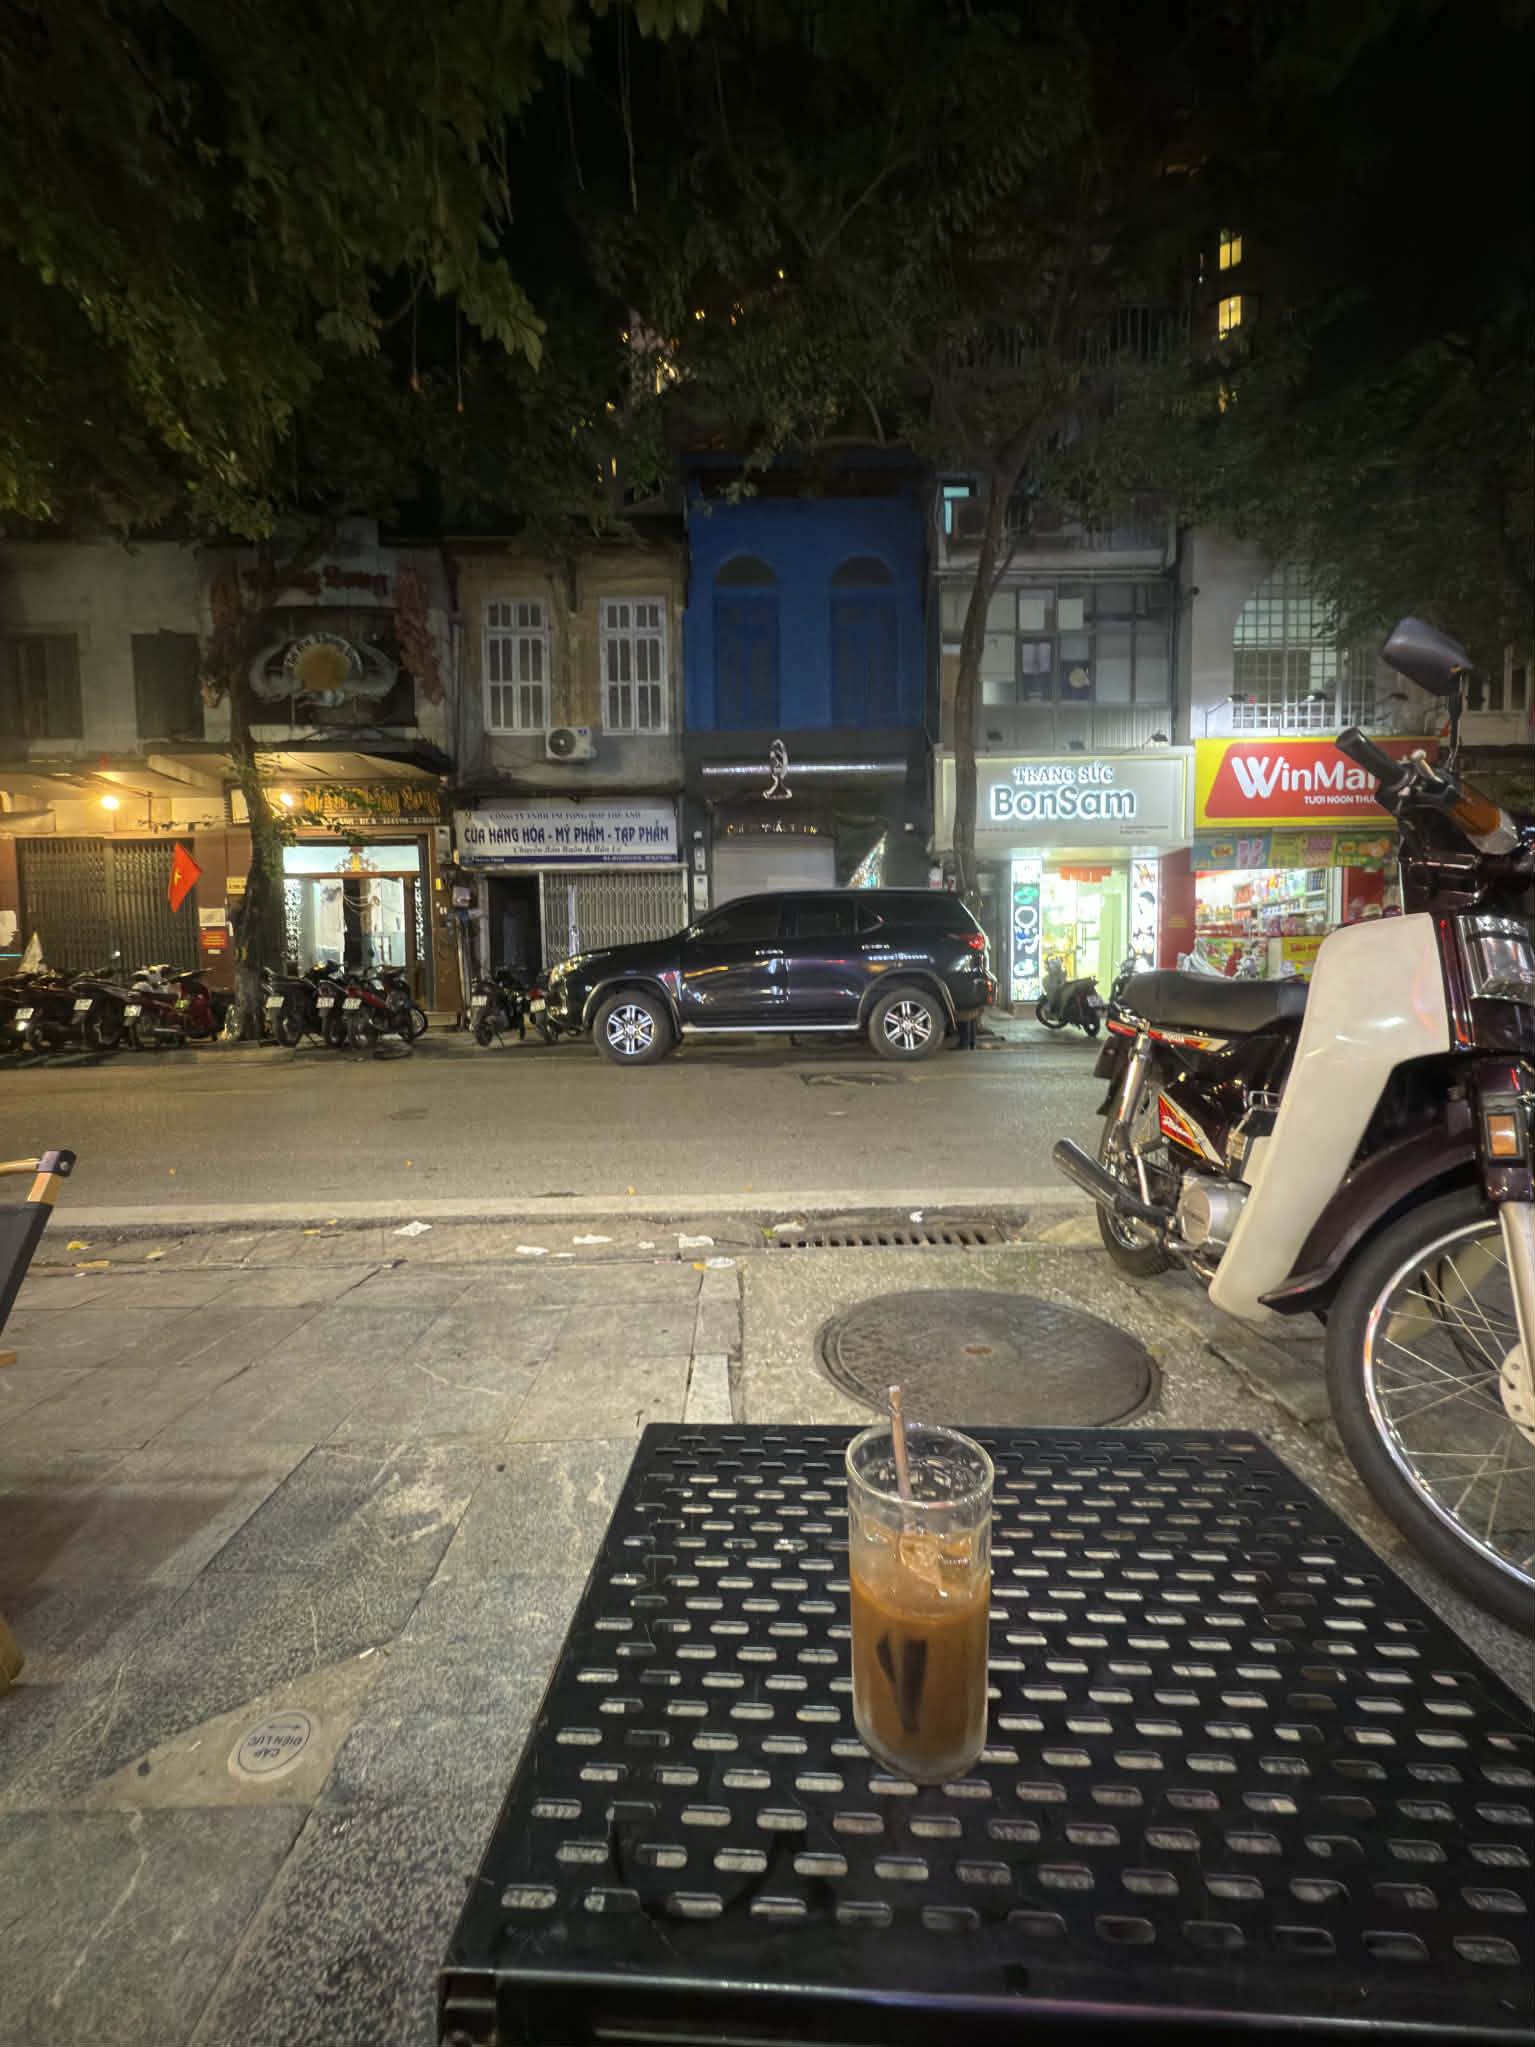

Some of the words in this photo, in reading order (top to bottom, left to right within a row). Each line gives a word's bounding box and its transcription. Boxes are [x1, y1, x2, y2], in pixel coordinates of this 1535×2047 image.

[1014, 766, 1075, 784] TRANG
[1078, 761, 1114, 784] SỨC
[1231, 756, 1376, 799] WinMar
[991, 785, 1136, 819] BonSam
[614, 827, 635, 846] TẠP
